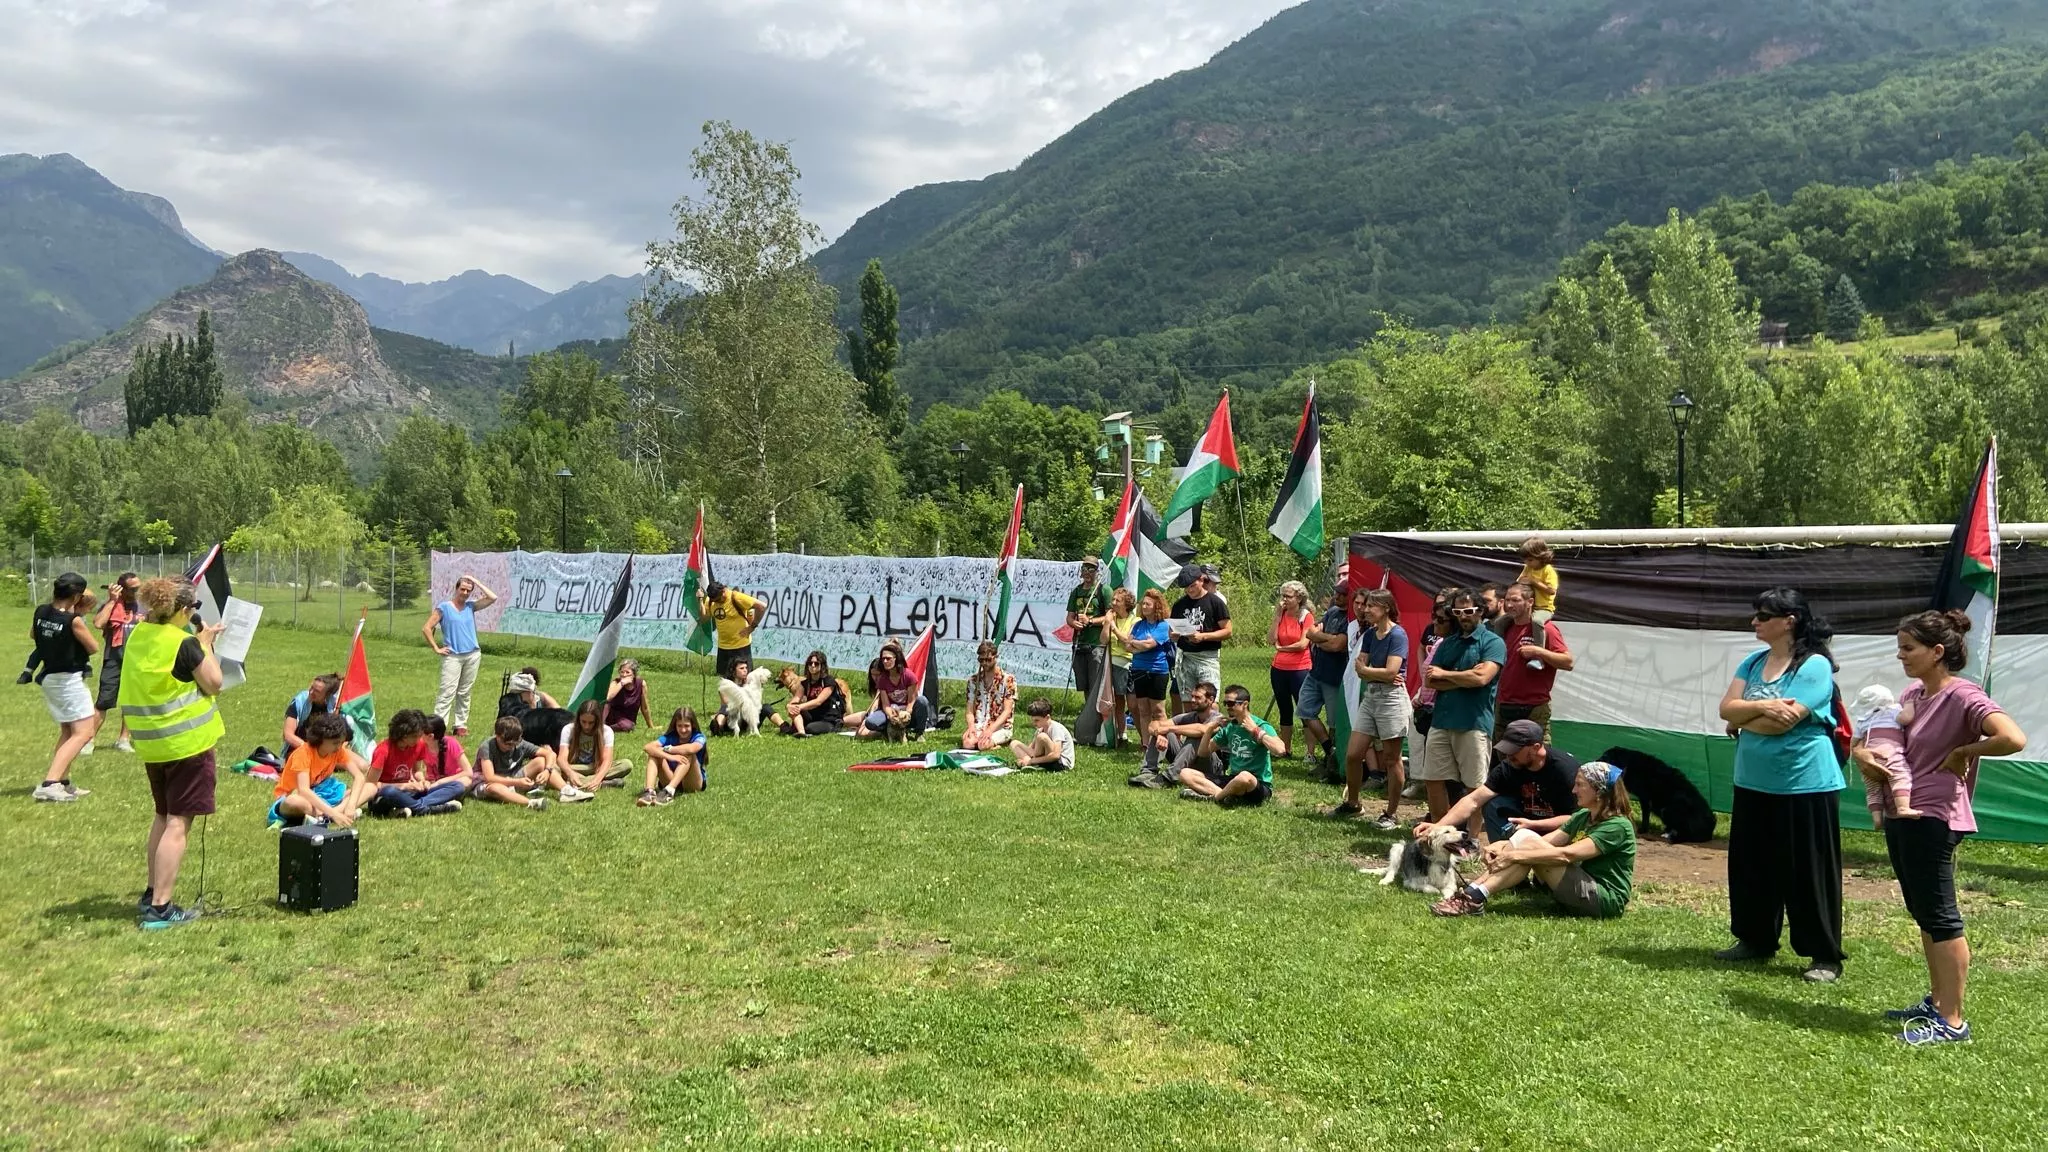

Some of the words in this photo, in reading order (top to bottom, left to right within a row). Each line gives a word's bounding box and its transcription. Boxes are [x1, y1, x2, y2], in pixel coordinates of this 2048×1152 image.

[515, 576, 547, 609] STOP
[554, 579, 651, 617] GENOCDIO
[656, 582, 688, 619] STO
